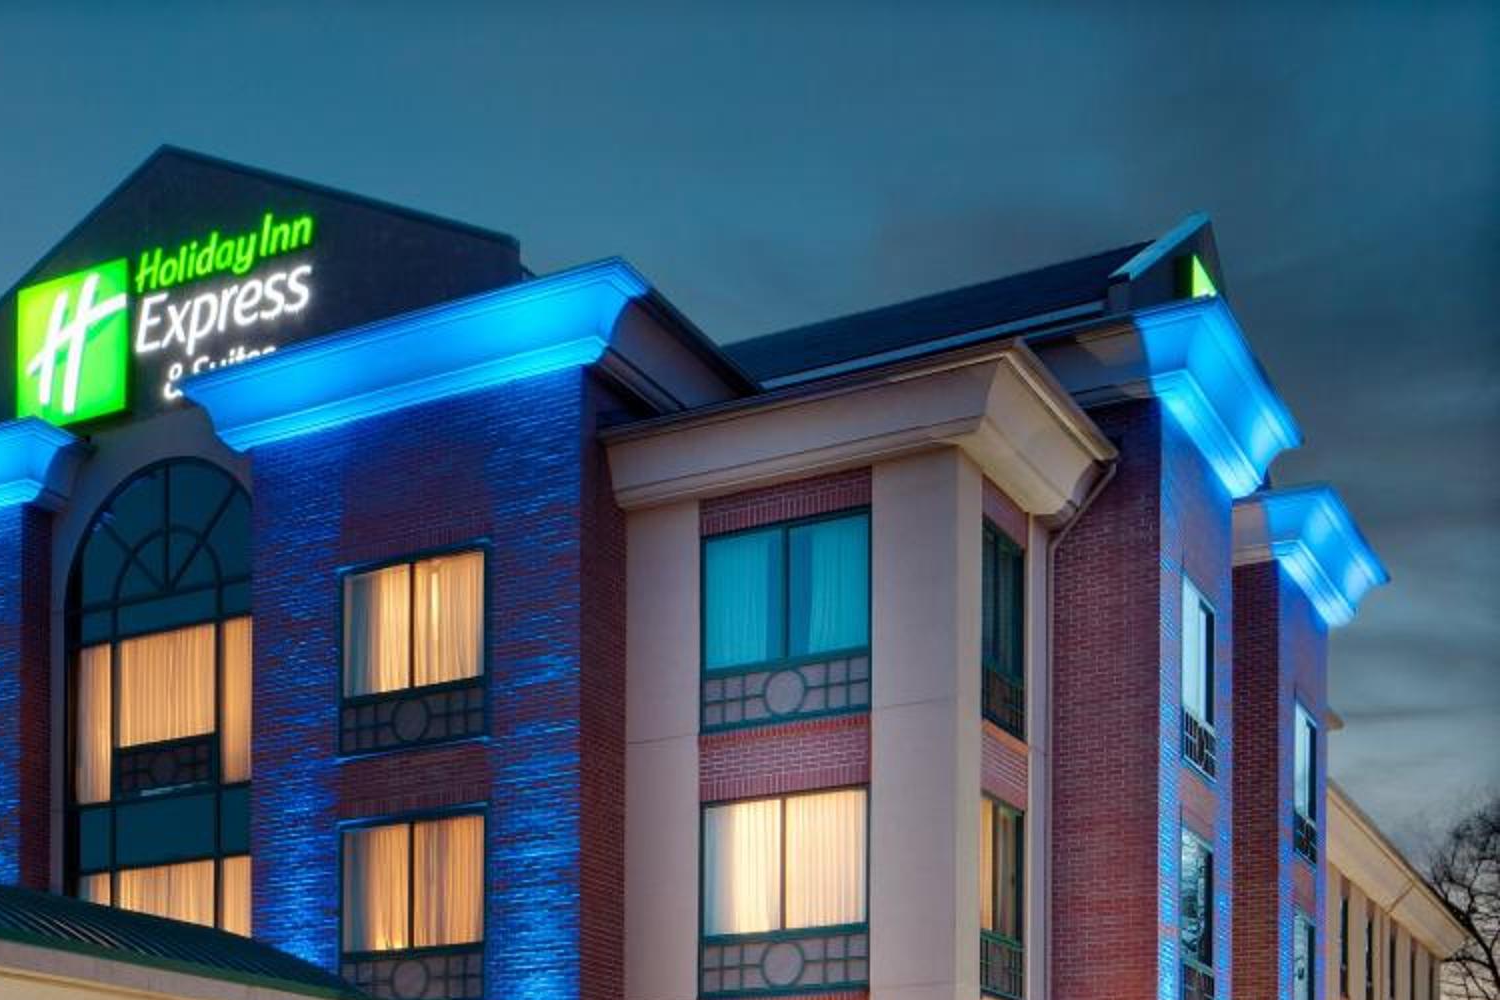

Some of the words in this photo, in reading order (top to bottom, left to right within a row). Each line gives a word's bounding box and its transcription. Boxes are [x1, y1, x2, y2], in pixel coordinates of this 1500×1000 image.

[135, 231, 257, 293] Holiday
[259, 212, 313, 257] Inn
[134, 264, 313, 357] Express
